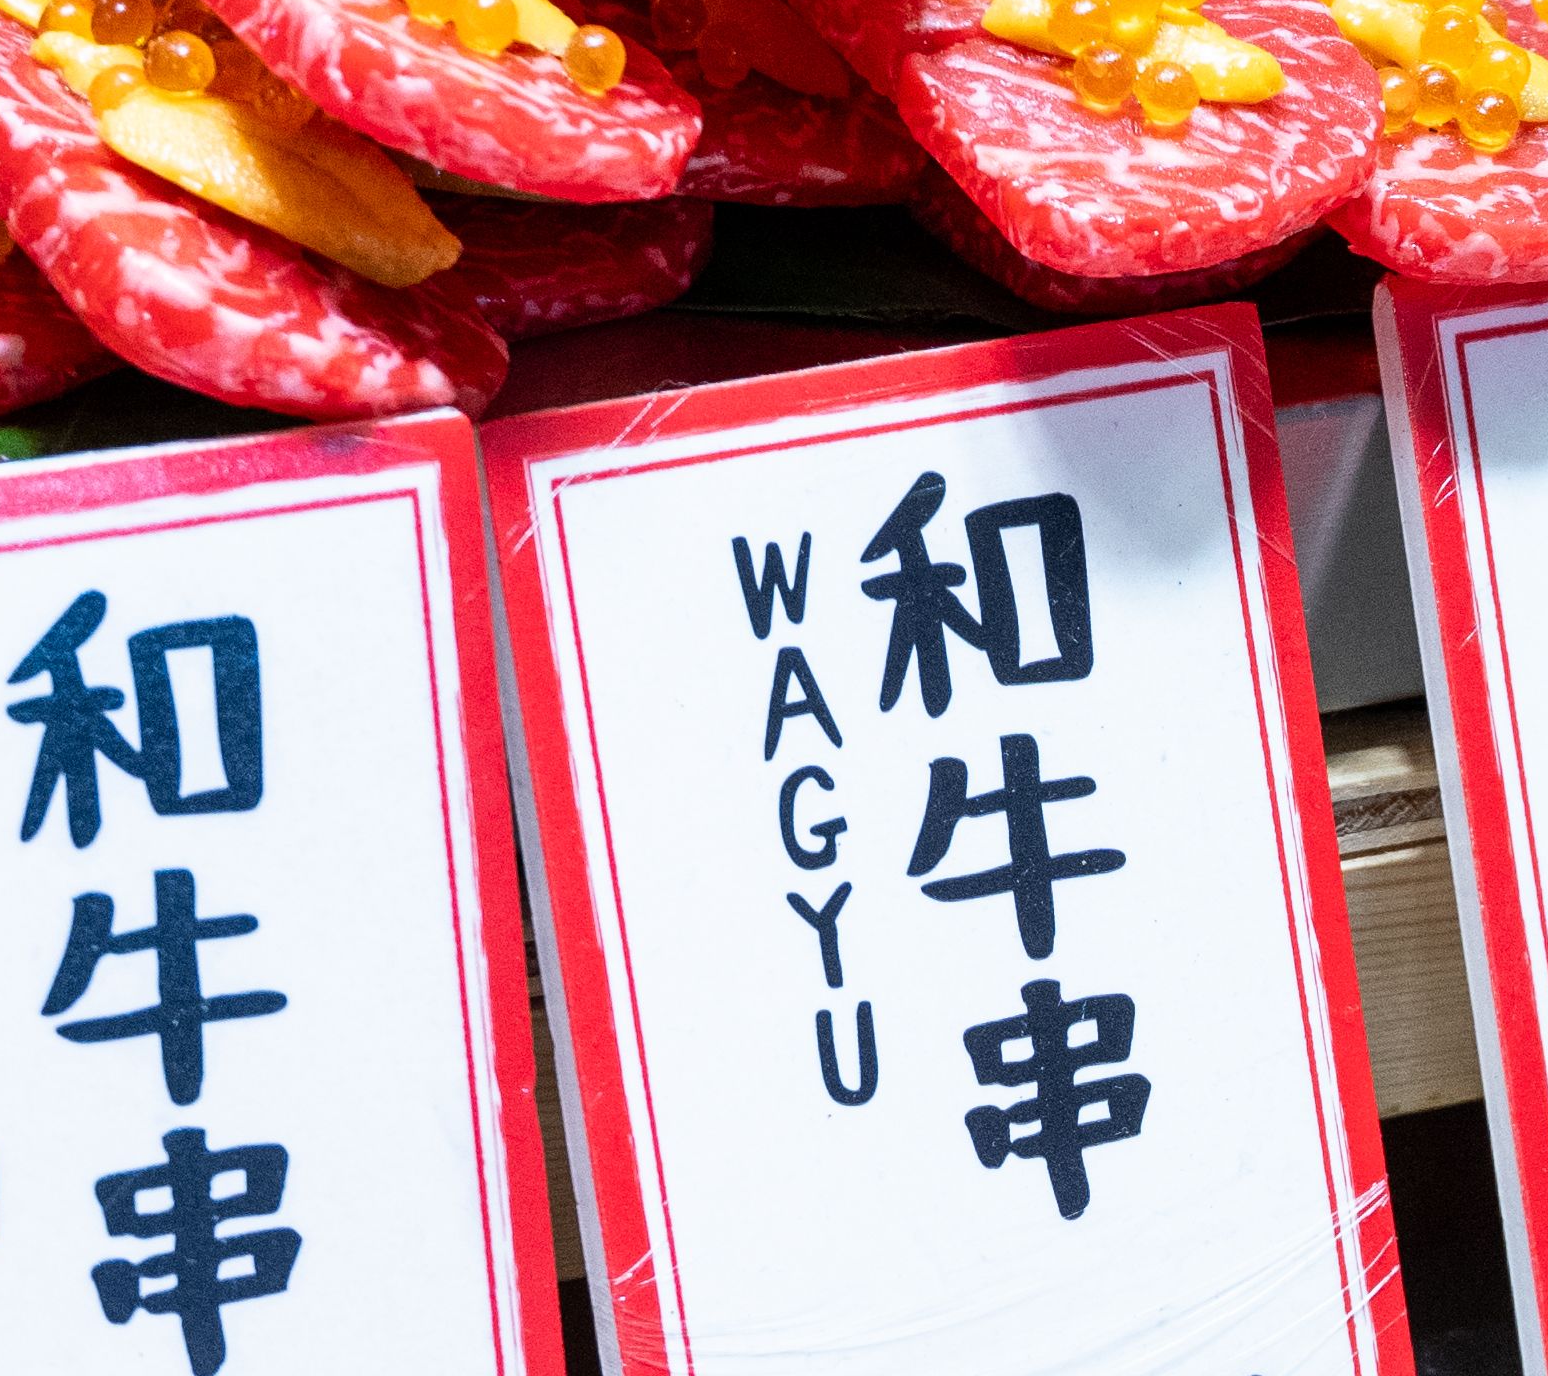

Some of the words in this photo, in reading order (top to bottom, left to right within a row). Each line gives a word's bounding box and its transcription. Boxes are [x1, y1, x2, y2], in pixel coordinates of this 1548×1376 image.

[730, 531, 879, 1107] WAGYU
[860, 470, 1153, 1221] 和牛串
